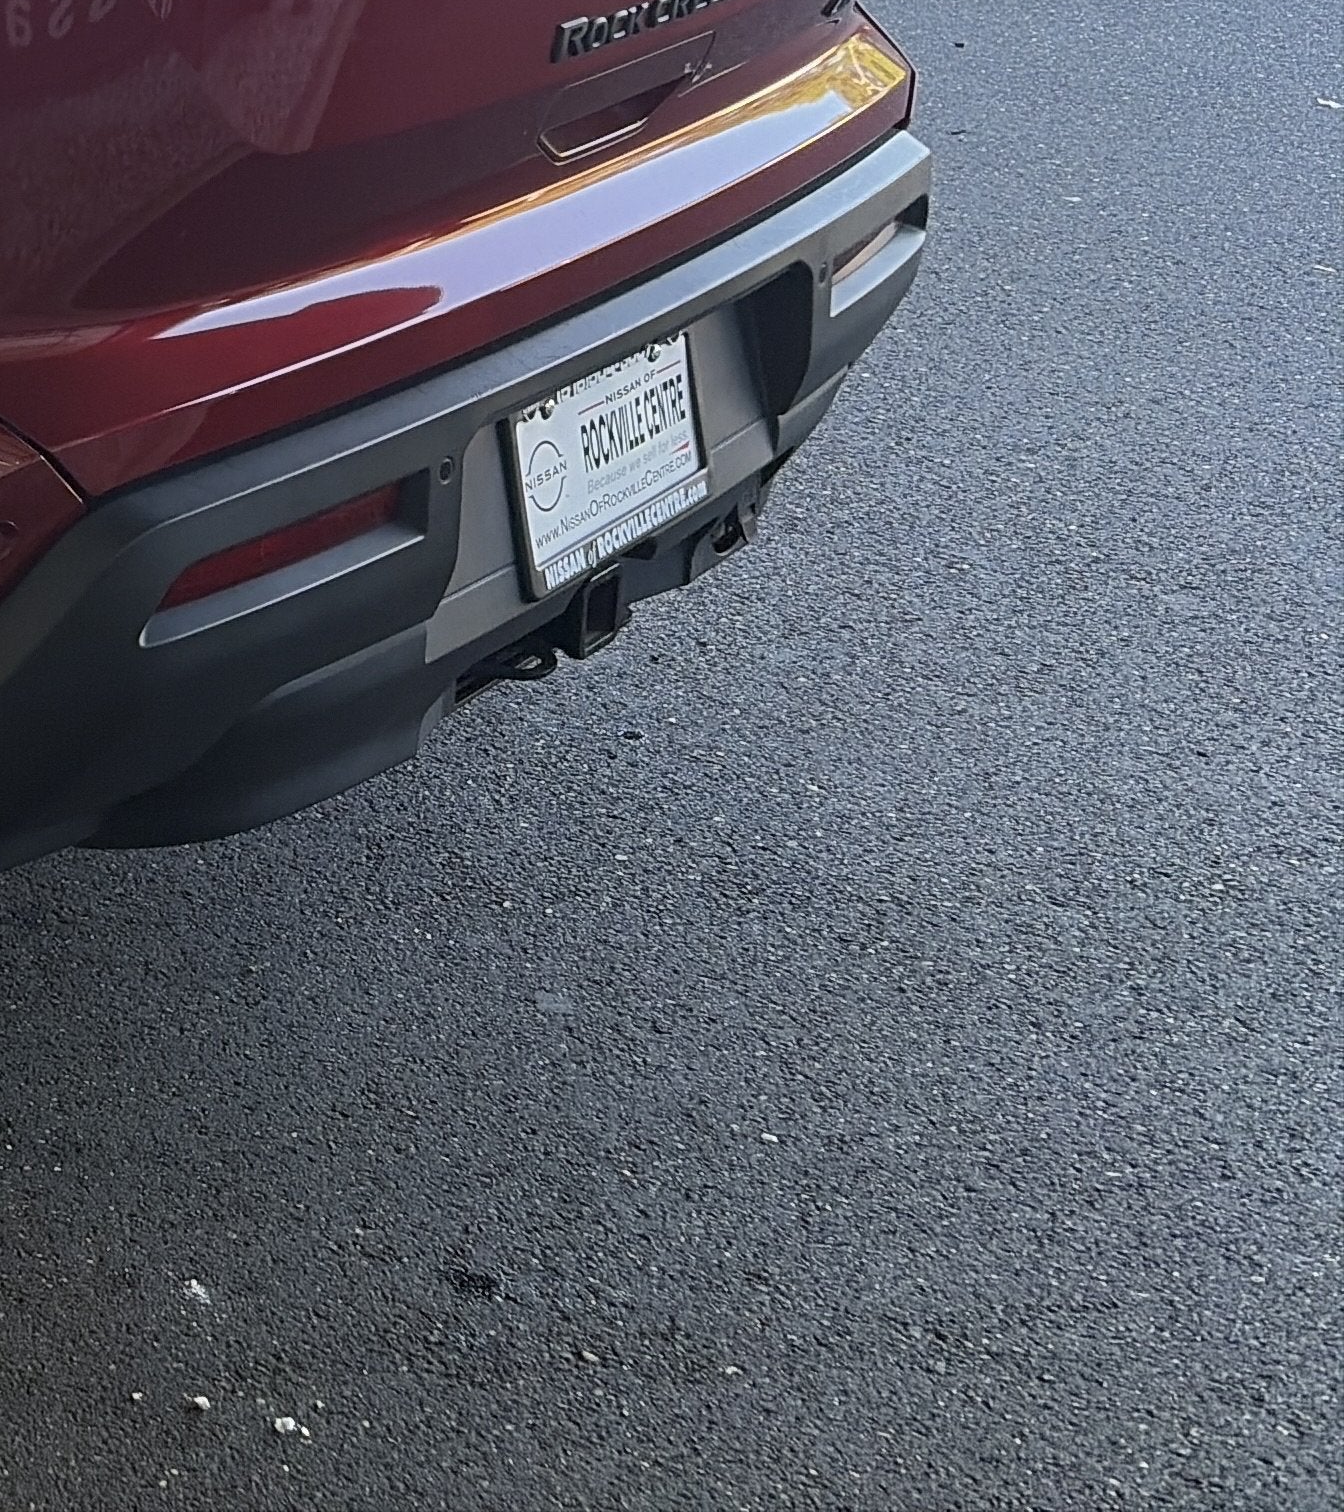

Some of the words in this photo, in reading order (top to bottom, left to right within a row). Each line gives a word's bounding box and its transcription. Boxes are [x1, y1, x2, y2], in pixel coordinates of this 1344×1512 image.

[605, 379, 642, 405] NISSAN
[643, 369, 657, 384] OF
[580, 397, 645, 473] ROCKVILLE
[643, 374, 686, 440] CENTRE
[525, 459, 568, 491] NISSAN
[588, 465, 627, 494] Because
[629, 460, 642, 474] we
[544, 549, 586, 591] NISSAN
[588, 539, 598, 568] of
